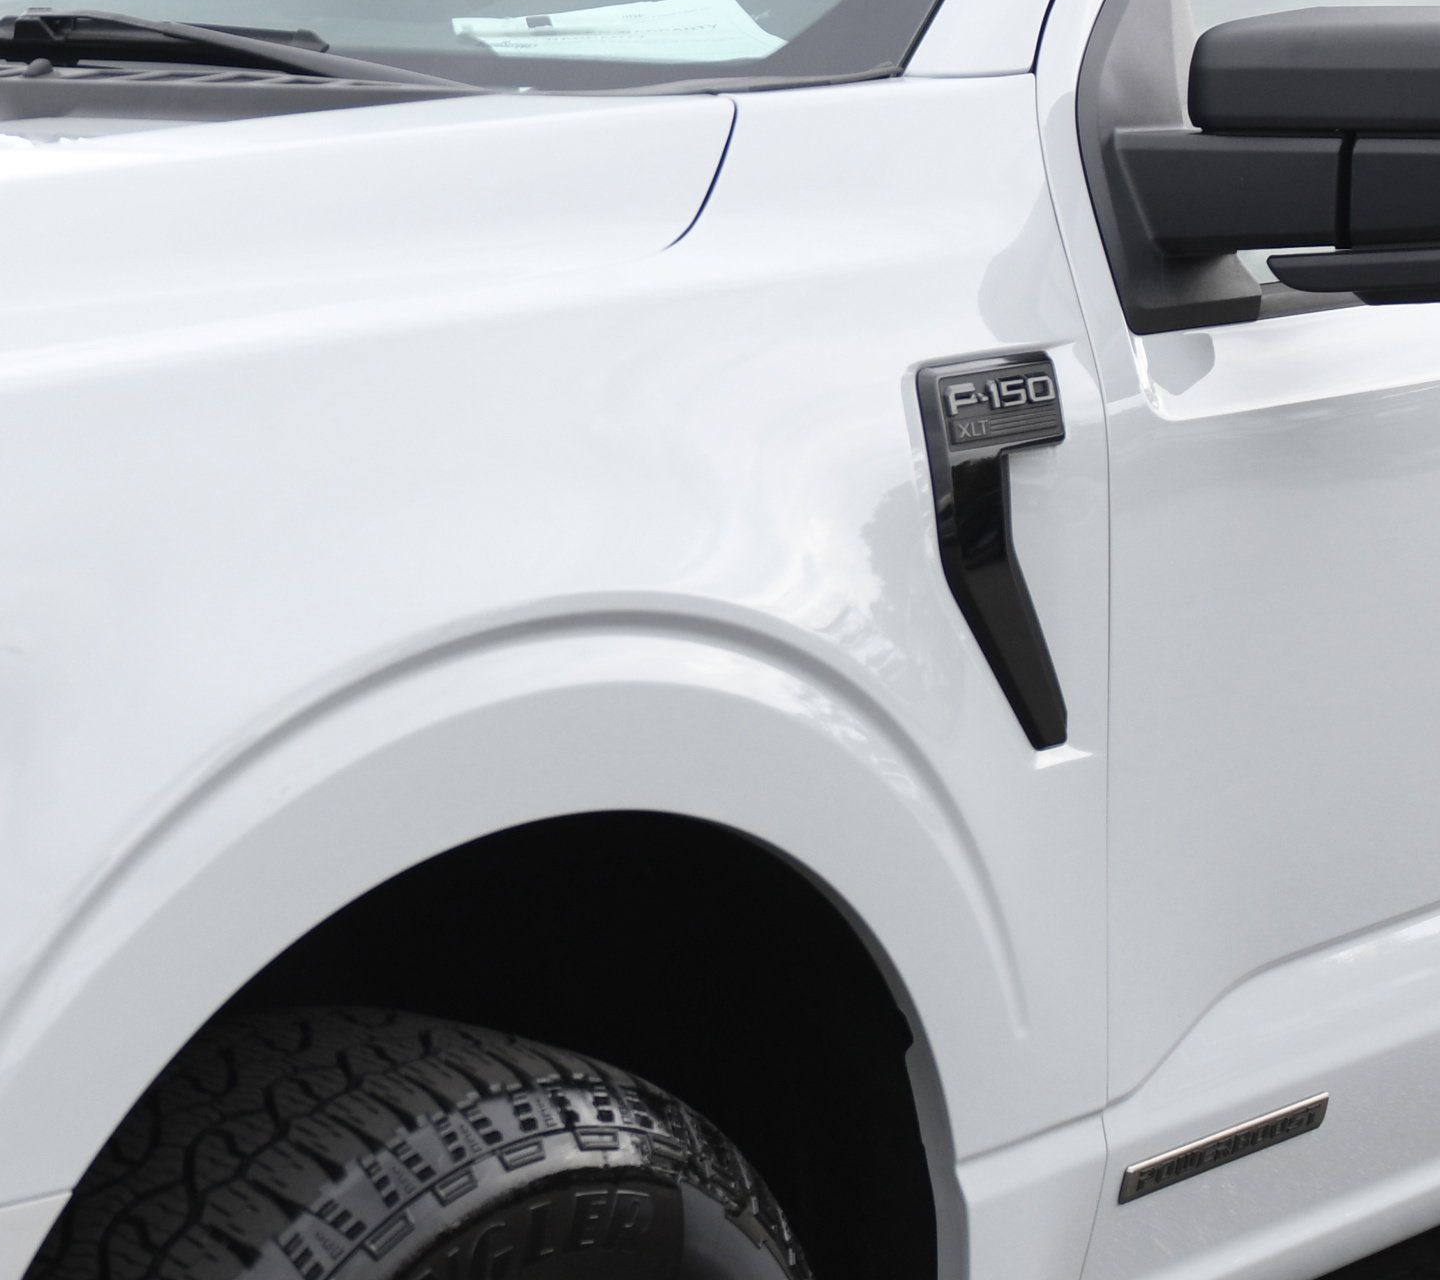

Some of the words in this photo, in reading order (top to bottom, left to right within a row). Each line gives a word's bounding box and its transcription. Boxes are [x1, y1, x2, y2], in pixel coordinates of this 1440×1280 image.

[945, 375, 1056, 415] F-150
[957, 419, 989, 439] XLT
[1136, 1103, 1322, 1192] POWERBOOST
